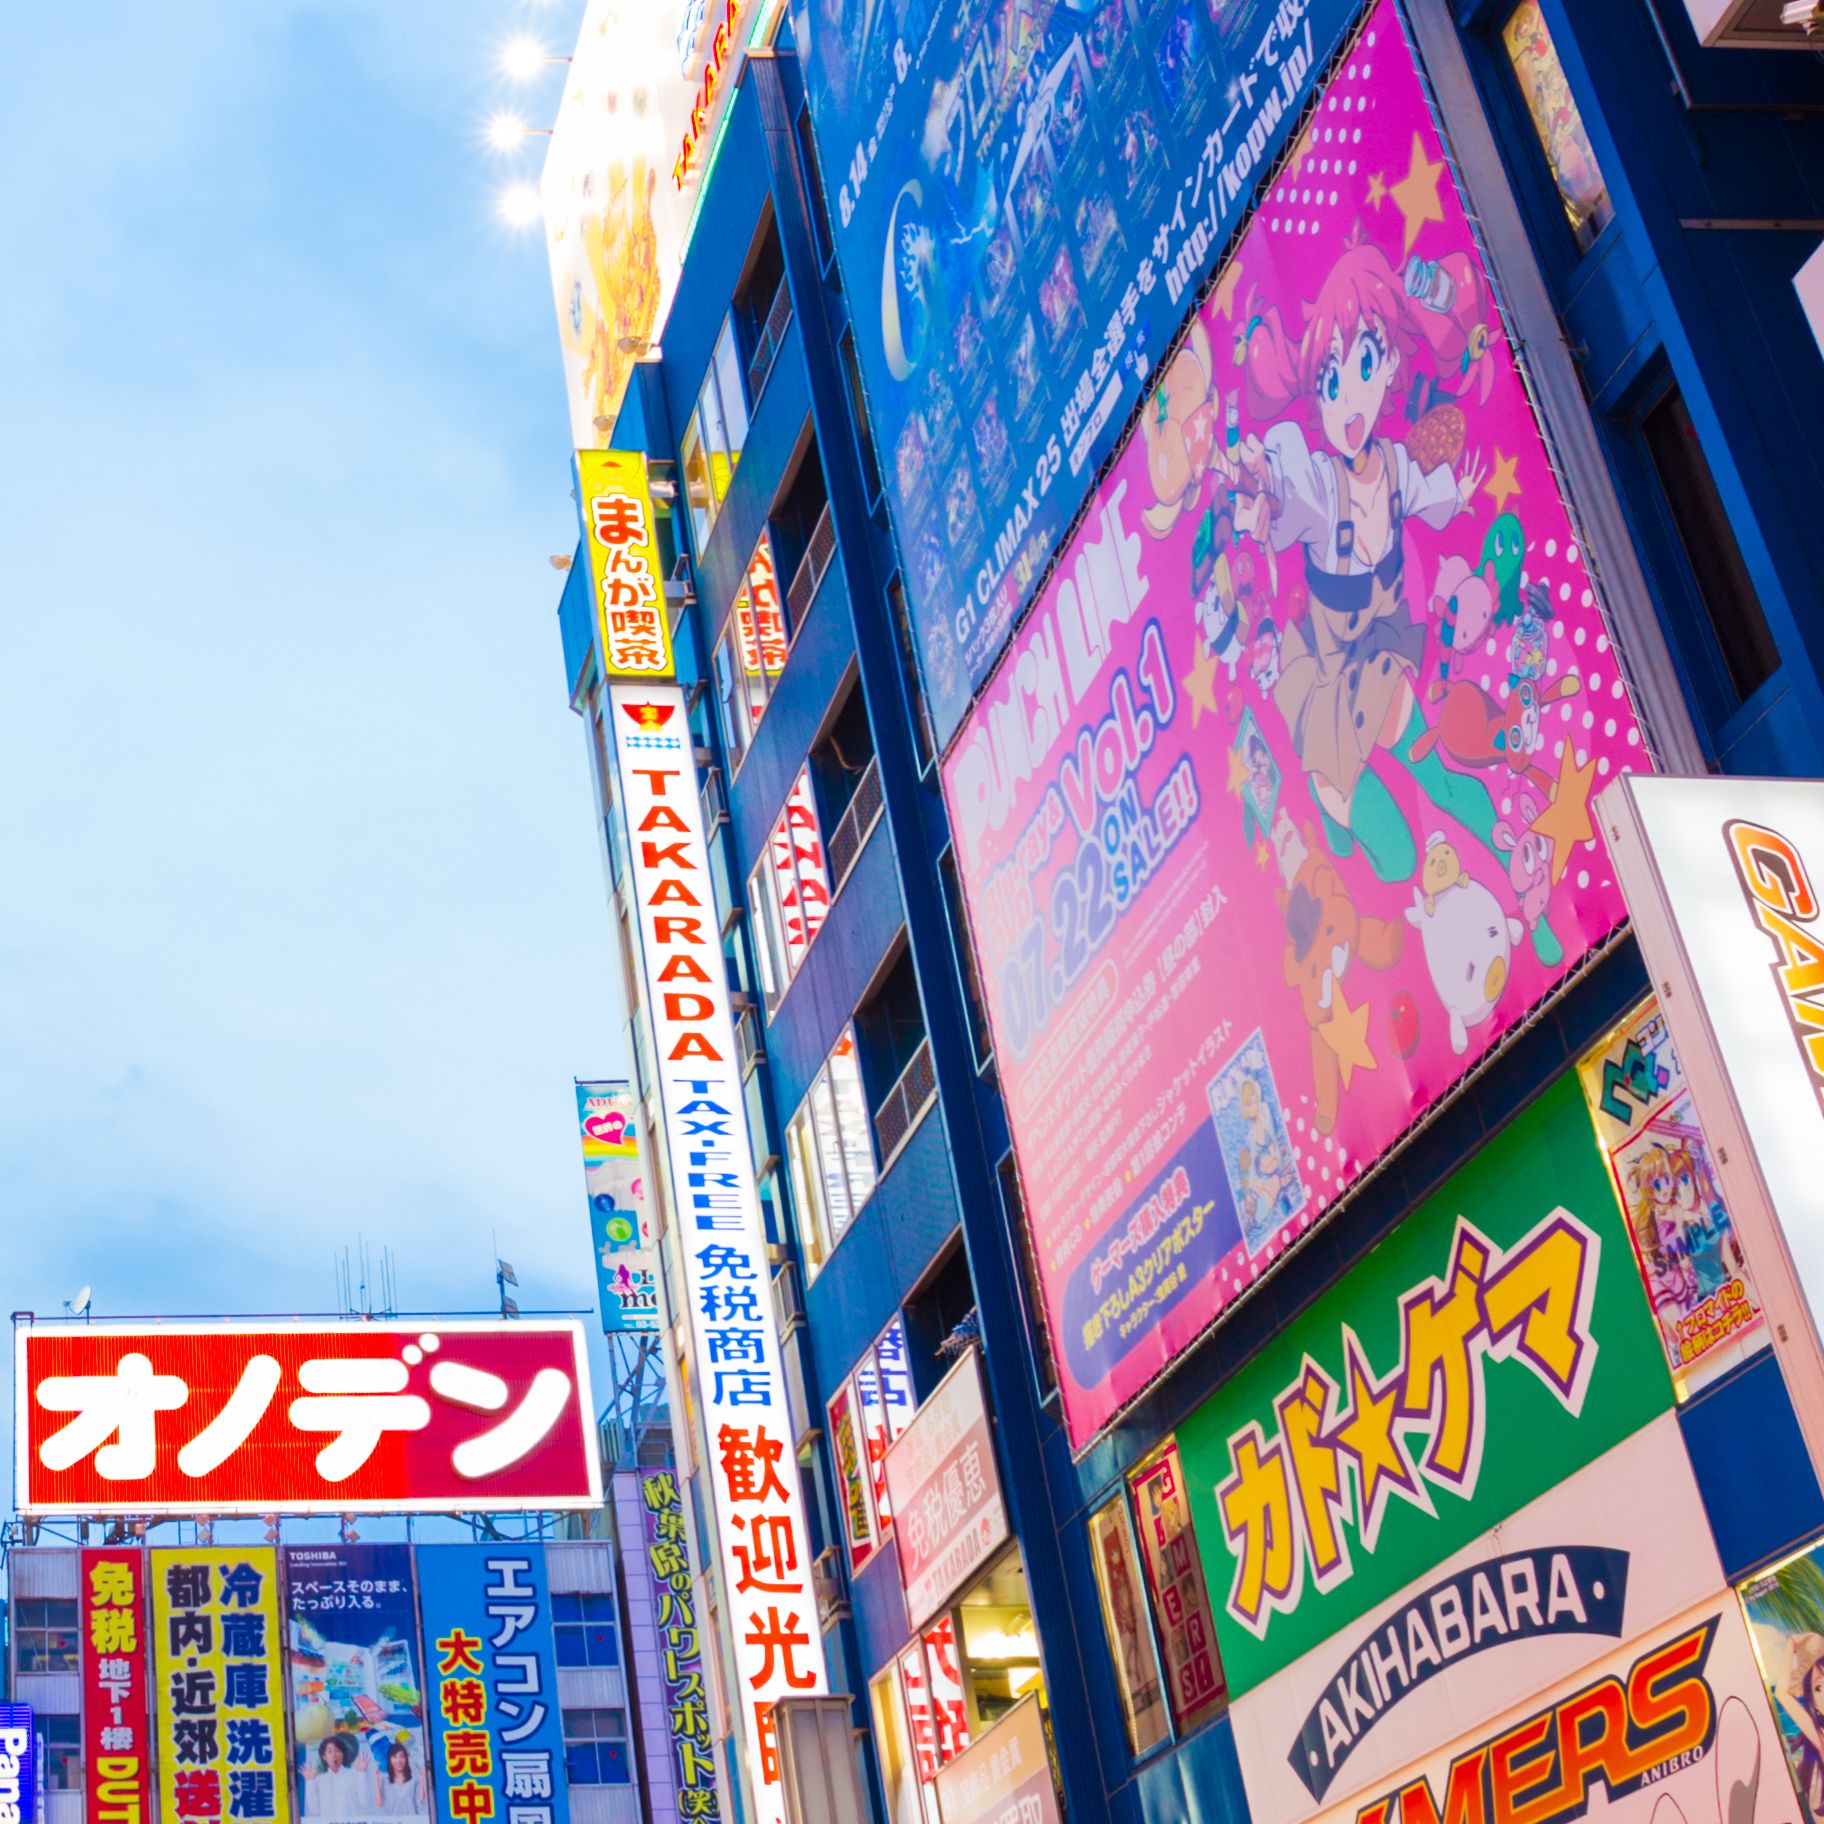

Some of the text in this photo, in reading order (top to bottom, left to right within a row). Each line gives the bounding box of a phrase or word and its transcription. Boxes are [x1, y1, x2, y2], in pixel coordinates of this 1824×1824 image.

[836, 132, 869, 234] 8.14
[1163, 12, 1321, 316] http://kopw.jp/
[590, 494, 668, 672] まんが喫茶
[953, 589, 978, 652] G1
[974, 473, 1040, 612] CLIMAX
[1034, 428, 1063, 500] 25
[952, 607, 1071, 874] PUNCH
[1051, 469, 1152, 709] LINE
[1057, 611, 1178, 854] Vol.1
[1099, 752, 1199, 913] ON SALE!!
[618, 768, 725, 1064] TAKARADA
[995, 824, 1117, 1065] 07.22
[1088, 1159, 1191, 1301] ゲーマーズ購入特典
[36, 1333, 572, 1482] オノデン
[693, 1243, 773, 1409] 免税商店
[90, 1559, 138, 1655] 免税
[289, 1550, 337, 1561] TOSHIBA
[290, 1580, 409, 1597] スペースそのまま、
[290, 1594, 386, 1611] たっぷり入る。
[1317, 1554, 1588, 1758] AKIHABARA
[1641, 1743, 1705, 1788] ANIBRO
